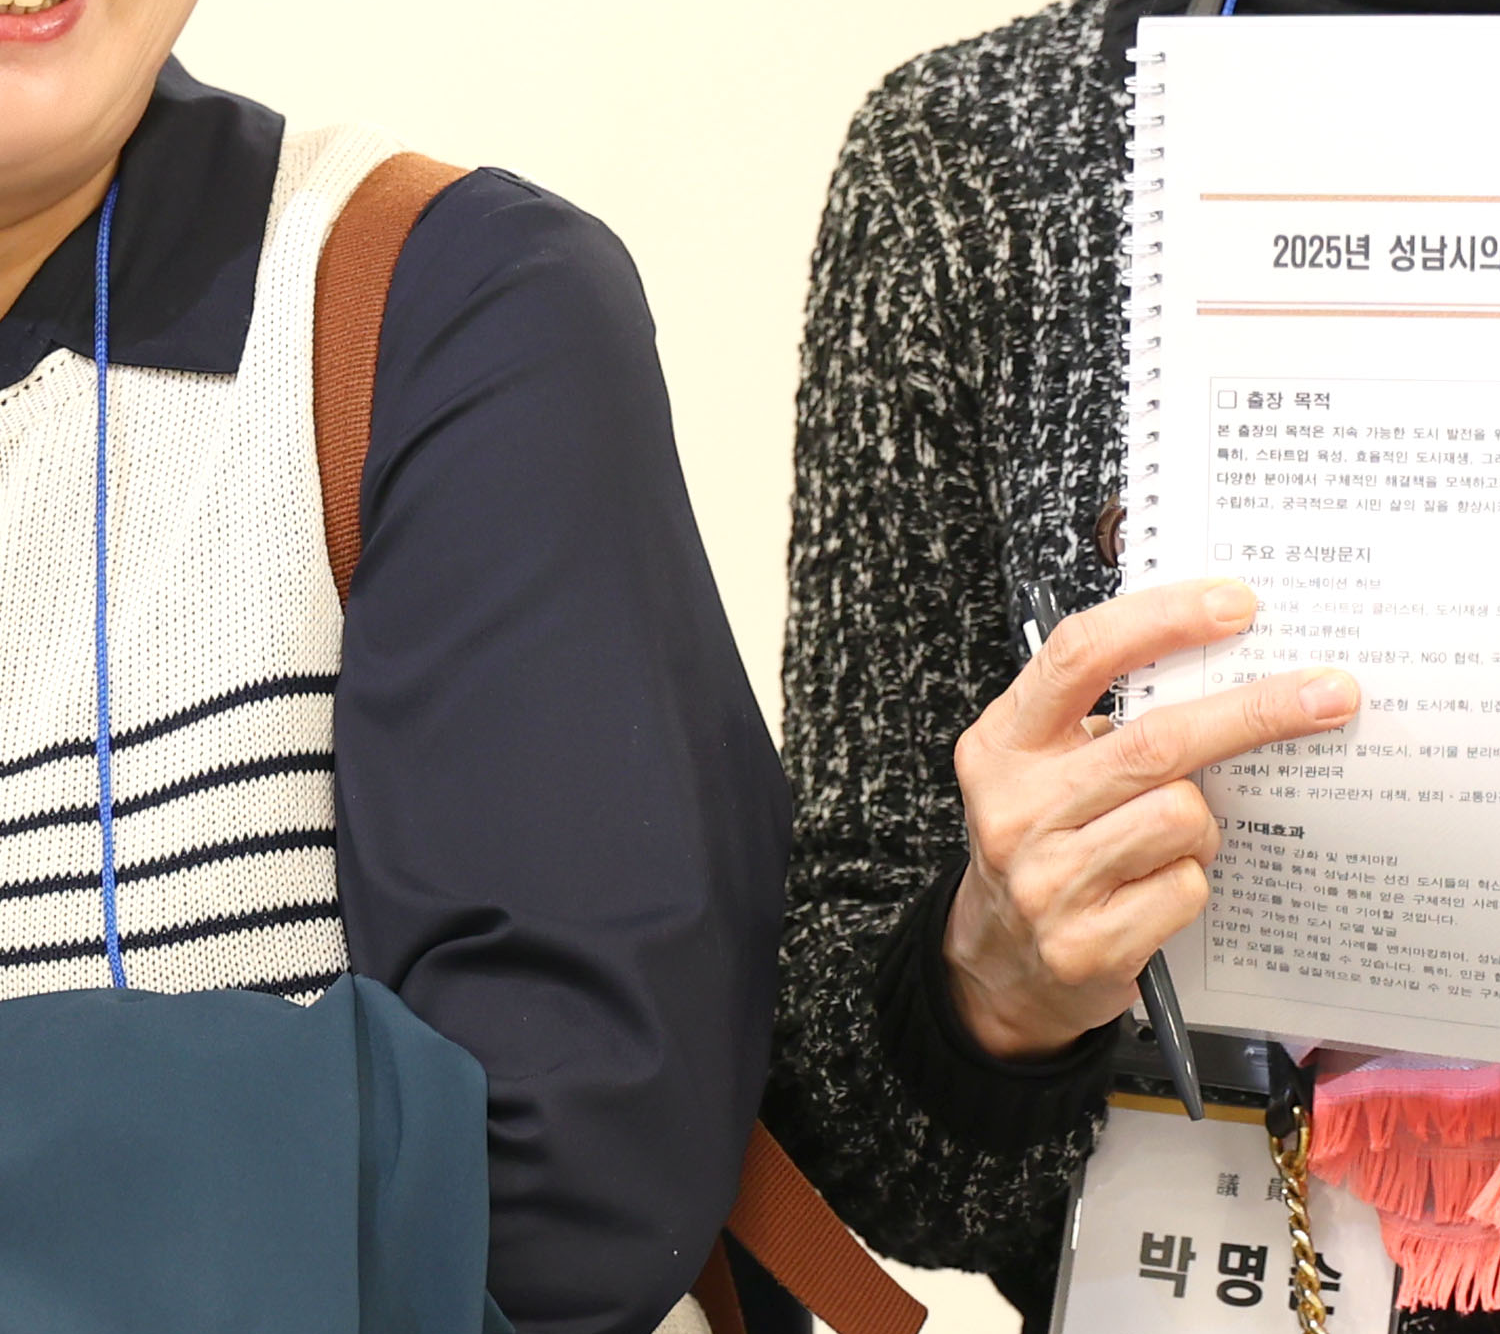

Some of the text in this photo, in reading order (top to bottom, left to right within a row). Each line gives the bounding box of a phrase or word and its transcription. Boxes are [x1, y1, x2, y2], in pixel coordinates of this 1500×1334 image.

[1273, 234, 1371, 271] 2025년
[1247, 391, 1330, 410] 출장 목적
[1241, 545, 1371, 563] 주요 공식방문지
[1308, 744, 1347, 758] 에너지
[1420, 745, 1458, 759] 폐기물
[1237, 785, 1262, 796] 주요
[1236, 819, 1304, 839] 기대효과
